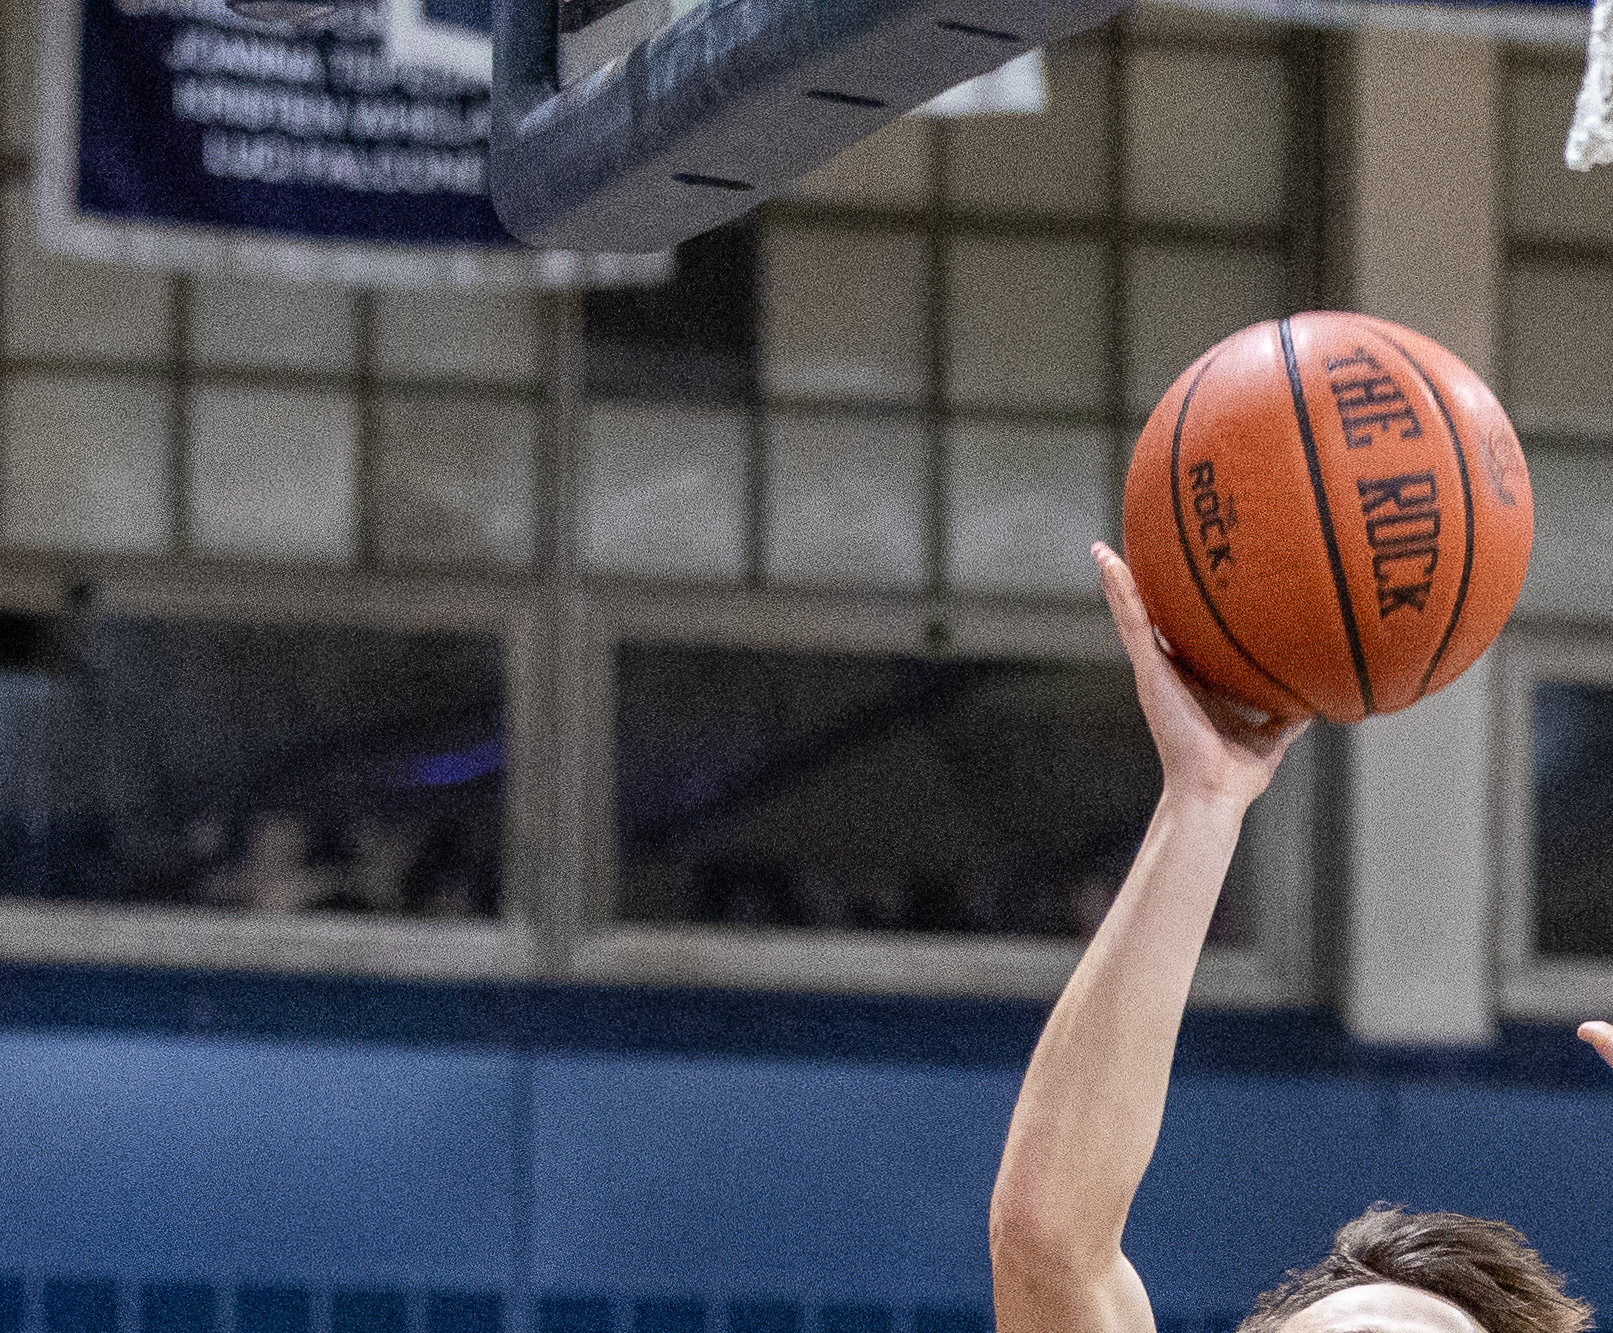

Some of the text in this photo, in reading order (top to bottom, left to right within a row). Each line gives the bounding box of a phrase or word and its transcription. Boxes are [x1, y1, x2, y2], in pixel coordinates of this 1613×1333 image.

[1188, 459, 1236, 572] ROCK
[1325, 347, 1441, 618] THE ROCK
